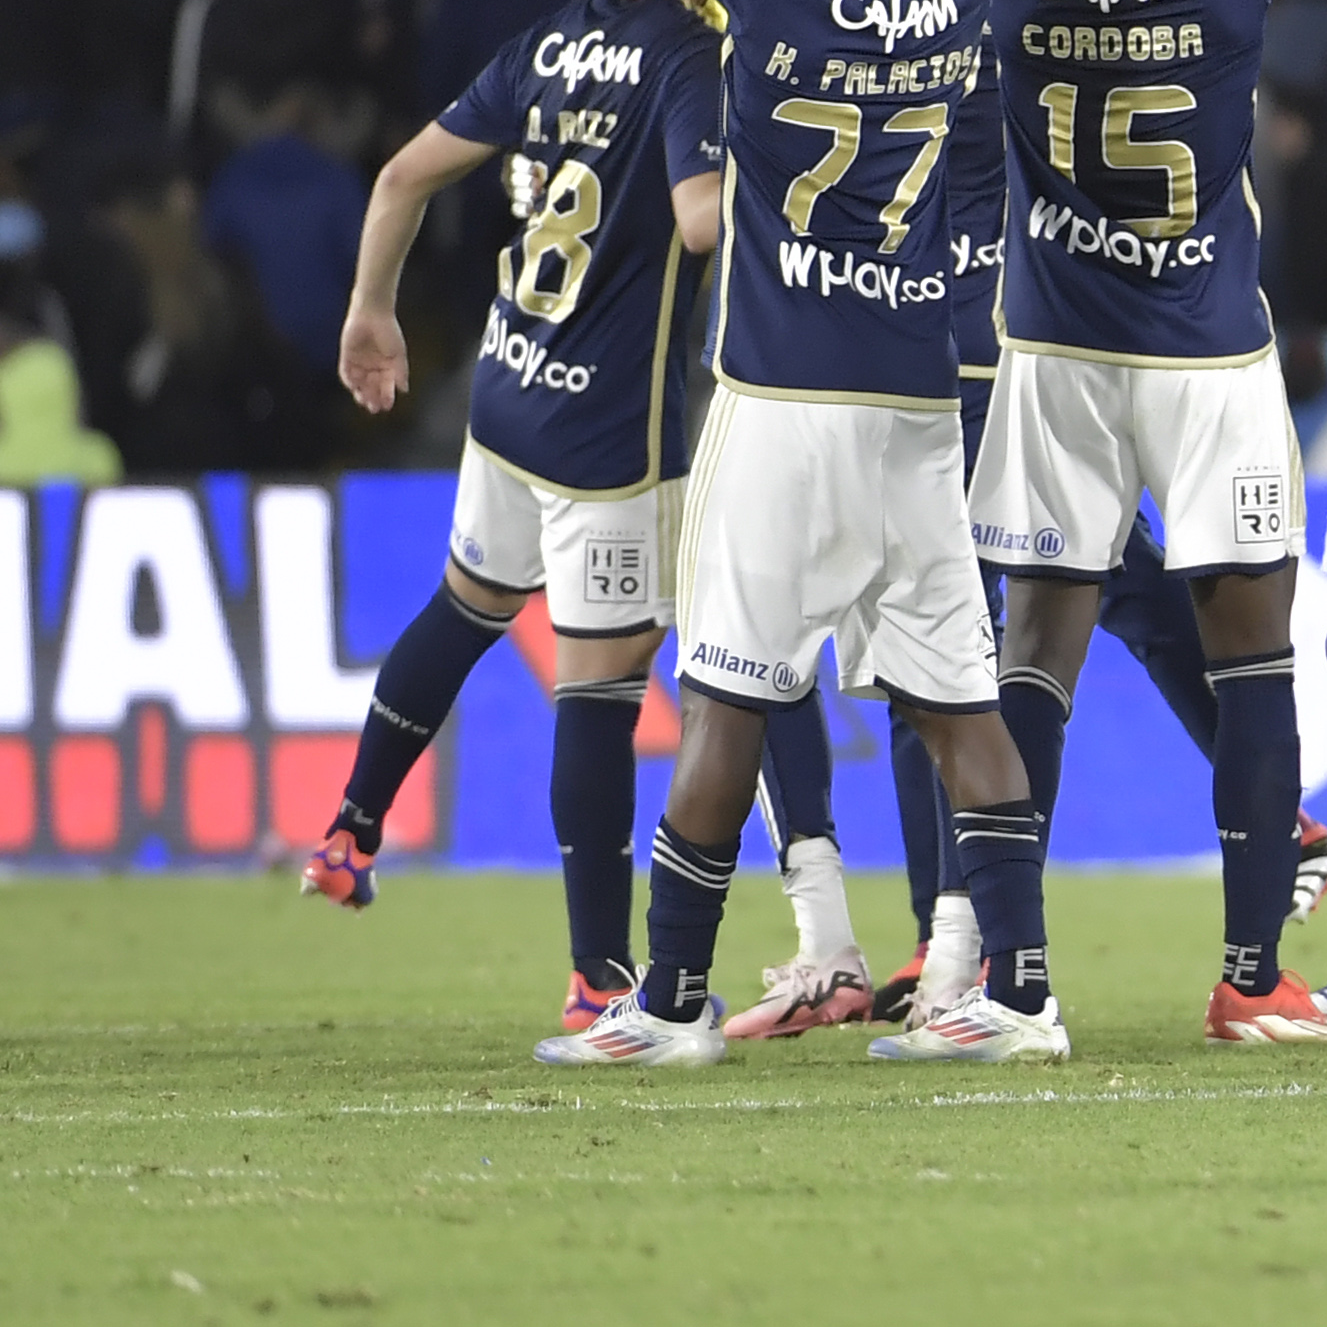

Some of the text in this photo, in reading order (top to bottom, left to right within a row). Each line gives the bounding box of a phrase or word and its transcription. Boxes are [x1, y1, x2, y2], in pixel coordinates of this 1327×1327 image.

[1022, 23, 1204, 61] CORDOBA
[765, 41, 972, 95] K. PALACIOS
[771, 97, 949, 254] 77
[1038, 83, 1198, 239] 15
[971, 522, 1029, 552] Allianz
[691, 642, 770, 681] Allianz
